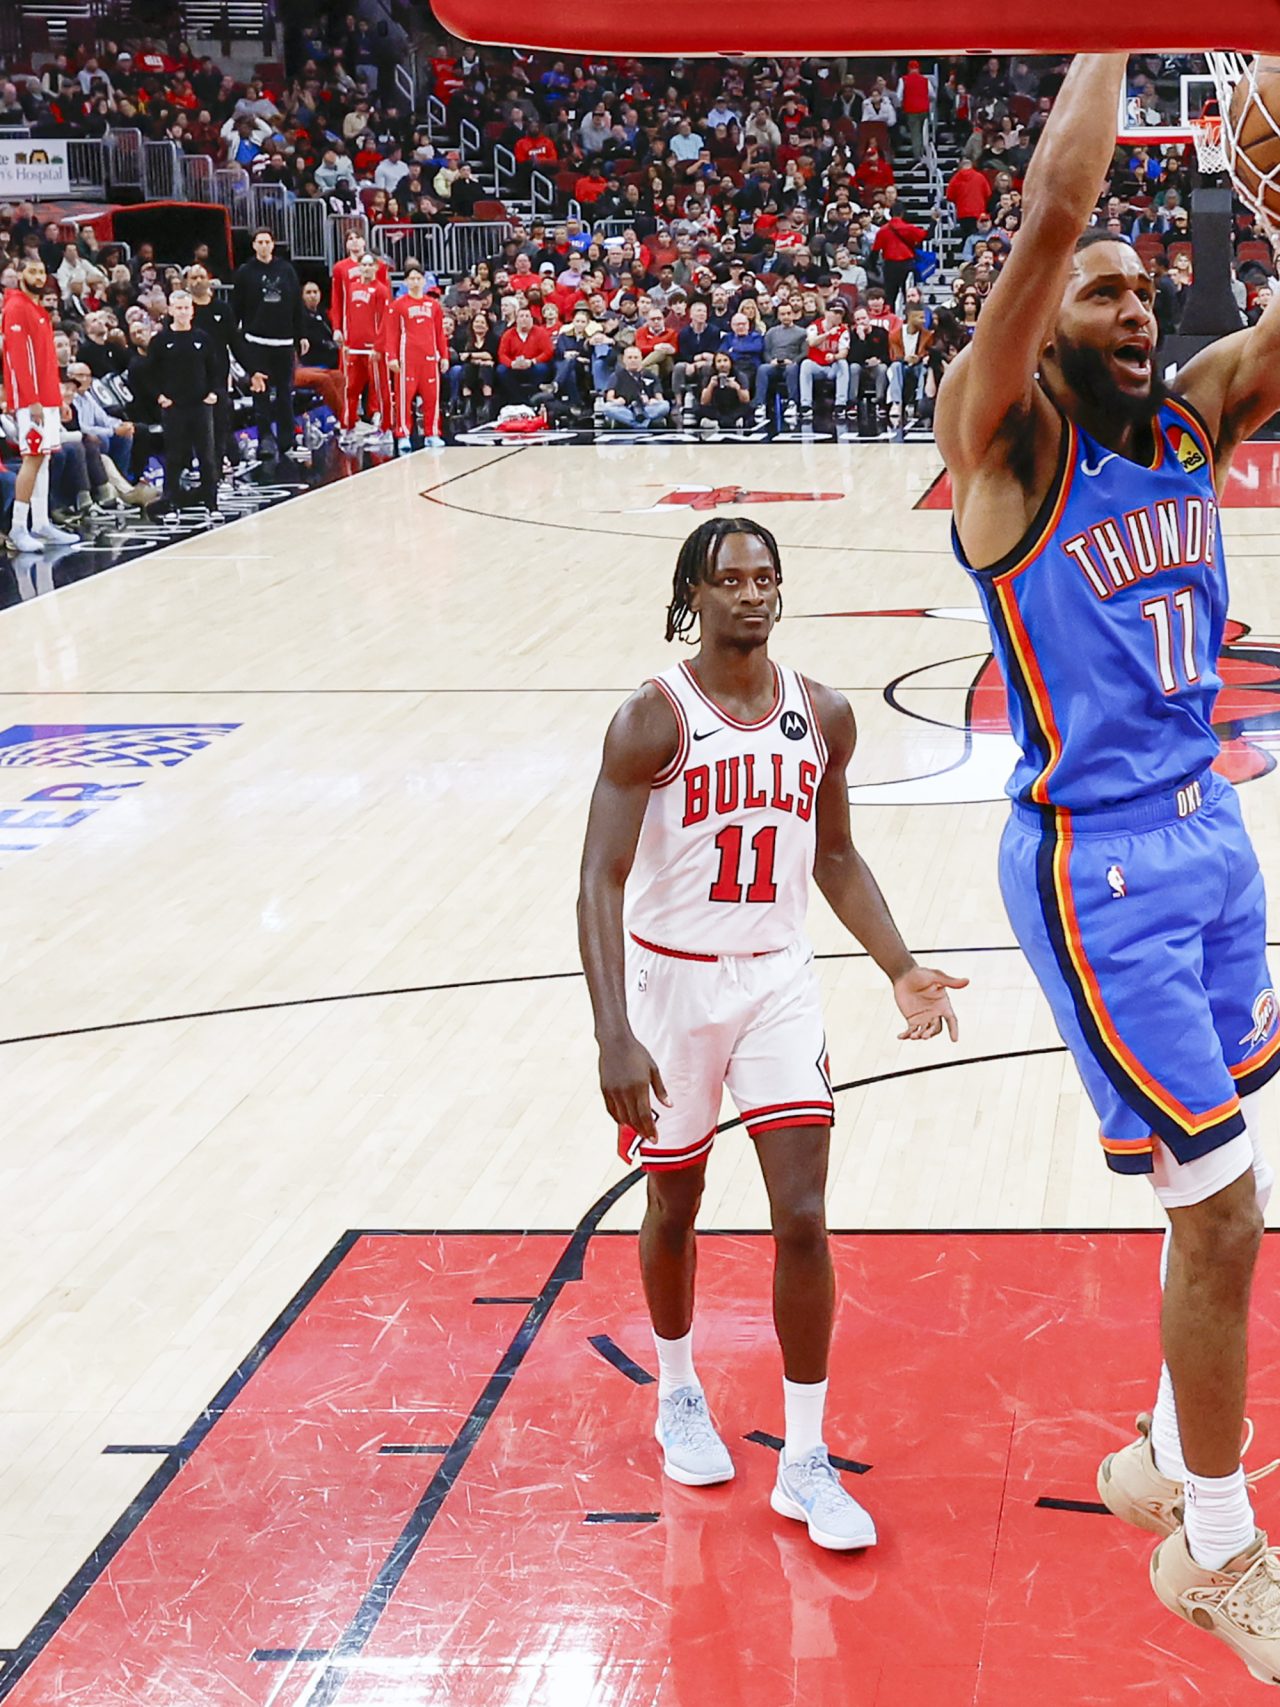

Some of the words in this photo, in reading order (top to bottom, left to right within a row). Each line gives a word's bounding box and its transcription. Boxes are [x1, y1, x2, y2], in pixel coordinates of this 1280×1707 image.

[16, 166, 63, 184] Hospital
[1061, 496, 1217, 600] THUNDE
[1140, 585, 1200, 696] 11
[682, 753, 817, 828] BULLS
[708, 824, 778, 903] 11
